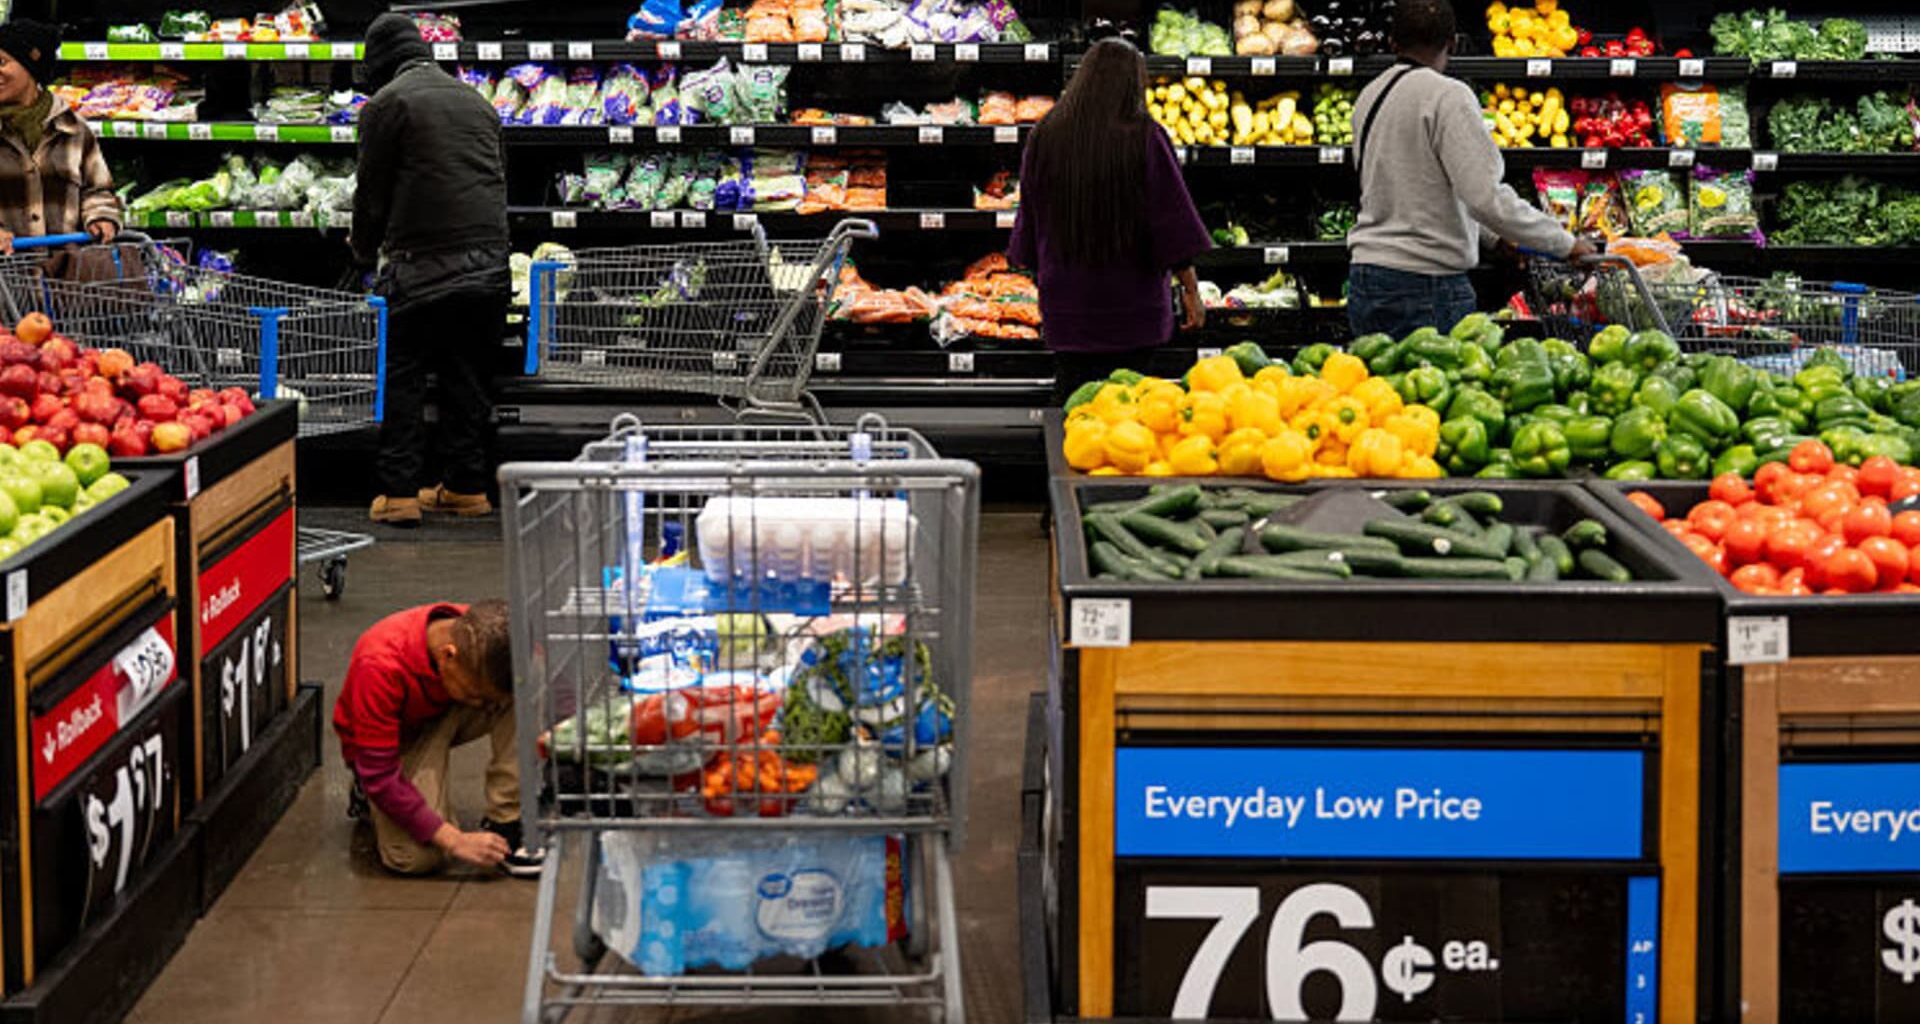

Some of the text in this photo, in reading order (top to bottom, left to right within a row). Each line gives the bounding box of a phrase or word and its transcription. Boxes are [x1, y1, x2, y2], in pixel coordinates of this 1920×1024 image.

[208, 576, 241, 619] Rollback
[57, 693, 103, 752] Rollback
[1145, 786, 1482, 828] Everyday Low Price
[1443, 940, 1499, 971] ea.
[1881, 899, 1920, 983] $
